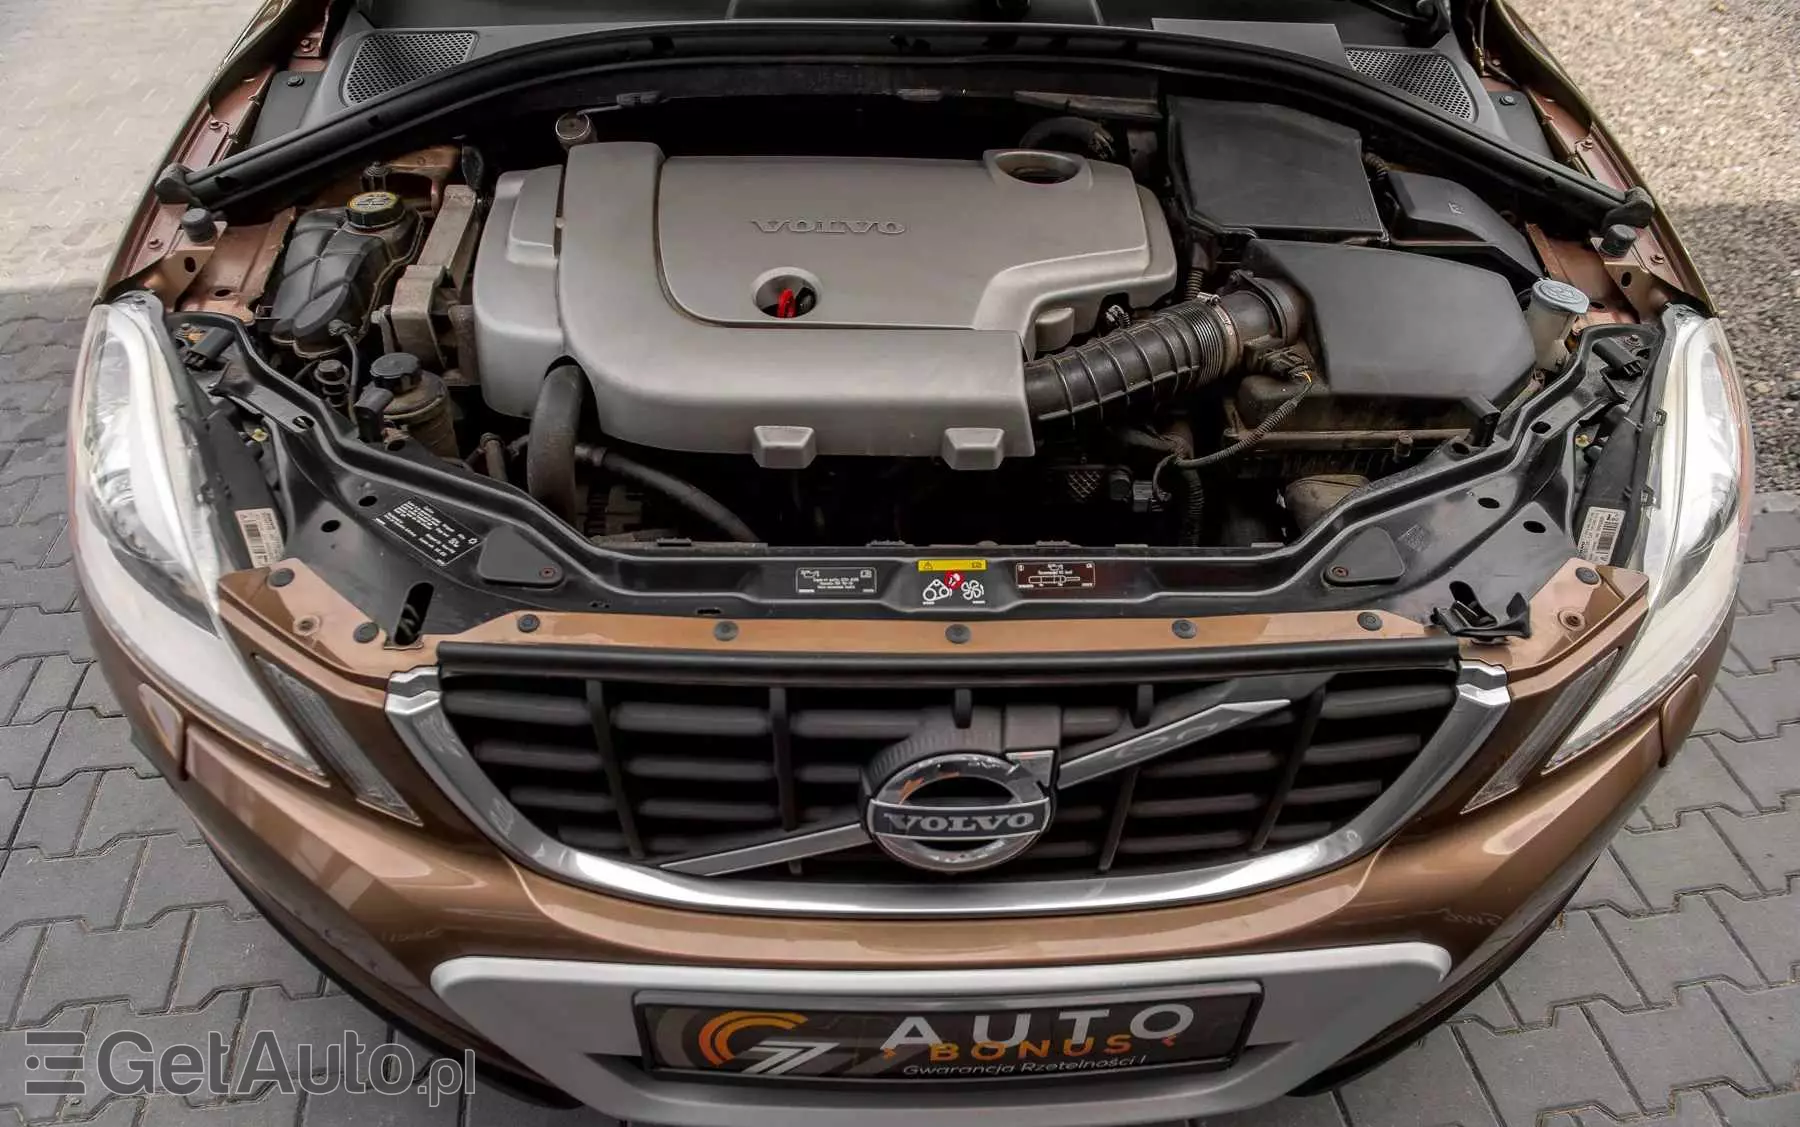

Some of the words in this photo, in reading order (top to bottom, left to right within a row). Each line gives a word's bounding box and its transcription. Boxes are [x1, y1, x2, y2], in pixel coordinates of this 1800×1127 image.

[751, 219, 906, 234] VOLVO
[883, 812, 1035, 832] VOLVO
[879, 1003, 1195, 1050] AUTO
[930, 1034, 1132, 1062] BONUS
[903, 1064, 1016, 1076] Gwarancja
[1020, 1056, 1136, 1073] Rzetelności
